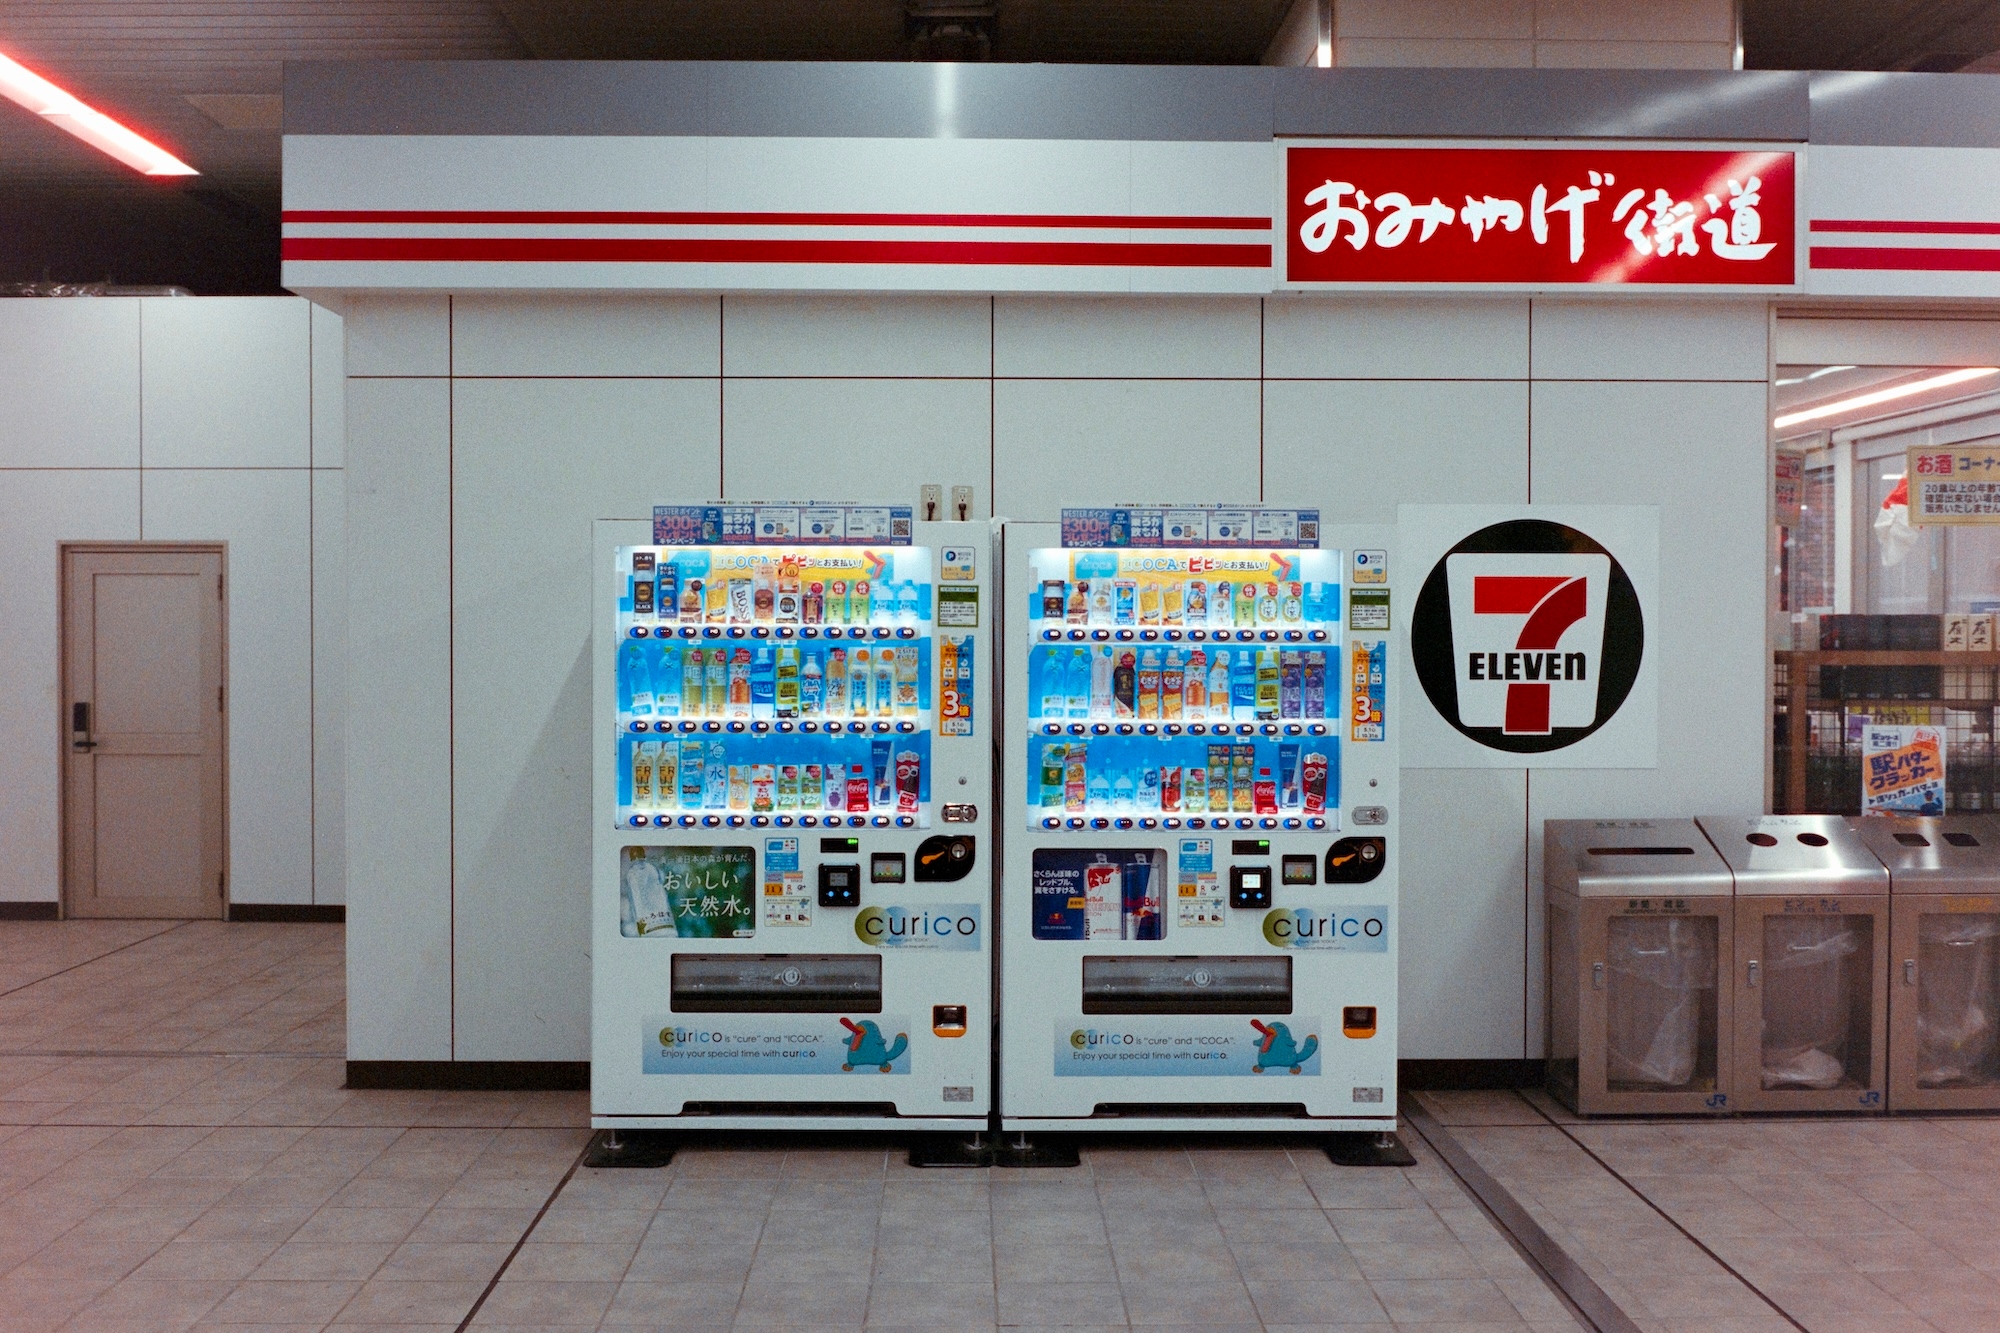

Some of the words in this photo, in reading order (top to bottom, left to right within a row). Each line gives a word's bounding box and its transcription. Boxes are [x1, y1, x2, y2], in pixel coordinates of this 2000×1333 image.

[1300, 170, 1778, 265] おみやげ街道
[1916, 454, 1953, 475] お酒
[1473, 576, 1587, 732] 7
[1870, 751, 1931, 776] 駅バター
[1870, 766, 1935, 790] クラッカー
[663, 870, 738, 891] おいしい
[1034, 870, 1080, 878] さくらんぼ味の
[1034, 886, 1078, 895] 翼をさずける。
[1039, 879, 1074, 887] レッドブル、
[678, 894, 751, 918] 天然水。
[866, 911, 976, 936] curico
[1273, 913, 1382, 937] curico
[664, 1030, 724, 1044] curico
[724, 1035, 731, 1043] is
[732, 1034, 761, 1043] “cure”
[763, 1034, 782, 1043] and
[1076, 1032, 1134, 1046] curico
[1136, 1037, 1142, 1045] is
[1144, 1037, 1172, 1045] “cure”
[1174, 1037, 1192, 1045] and
[661, 1050, 684, 1059] Enjoy
[708, 1050, 740, 1059] special
[742, 1050, 760, 1058] time
[762, 1050, 781, 1058] with
[782, 1049, 818, 1058] curico.
[1072, 1052, 1096, 1061] Enjoy
[1118, 1052, 1150, 1061] special
[1152, 1052, 1170, 1060] time
[1173, 1052, 1192, 1060] with
[1192, 1051, 1228, 1060] curico.
[1706, 1094, 1726, 1107] JR
[1858, 1092, 1880, 1104] JR
